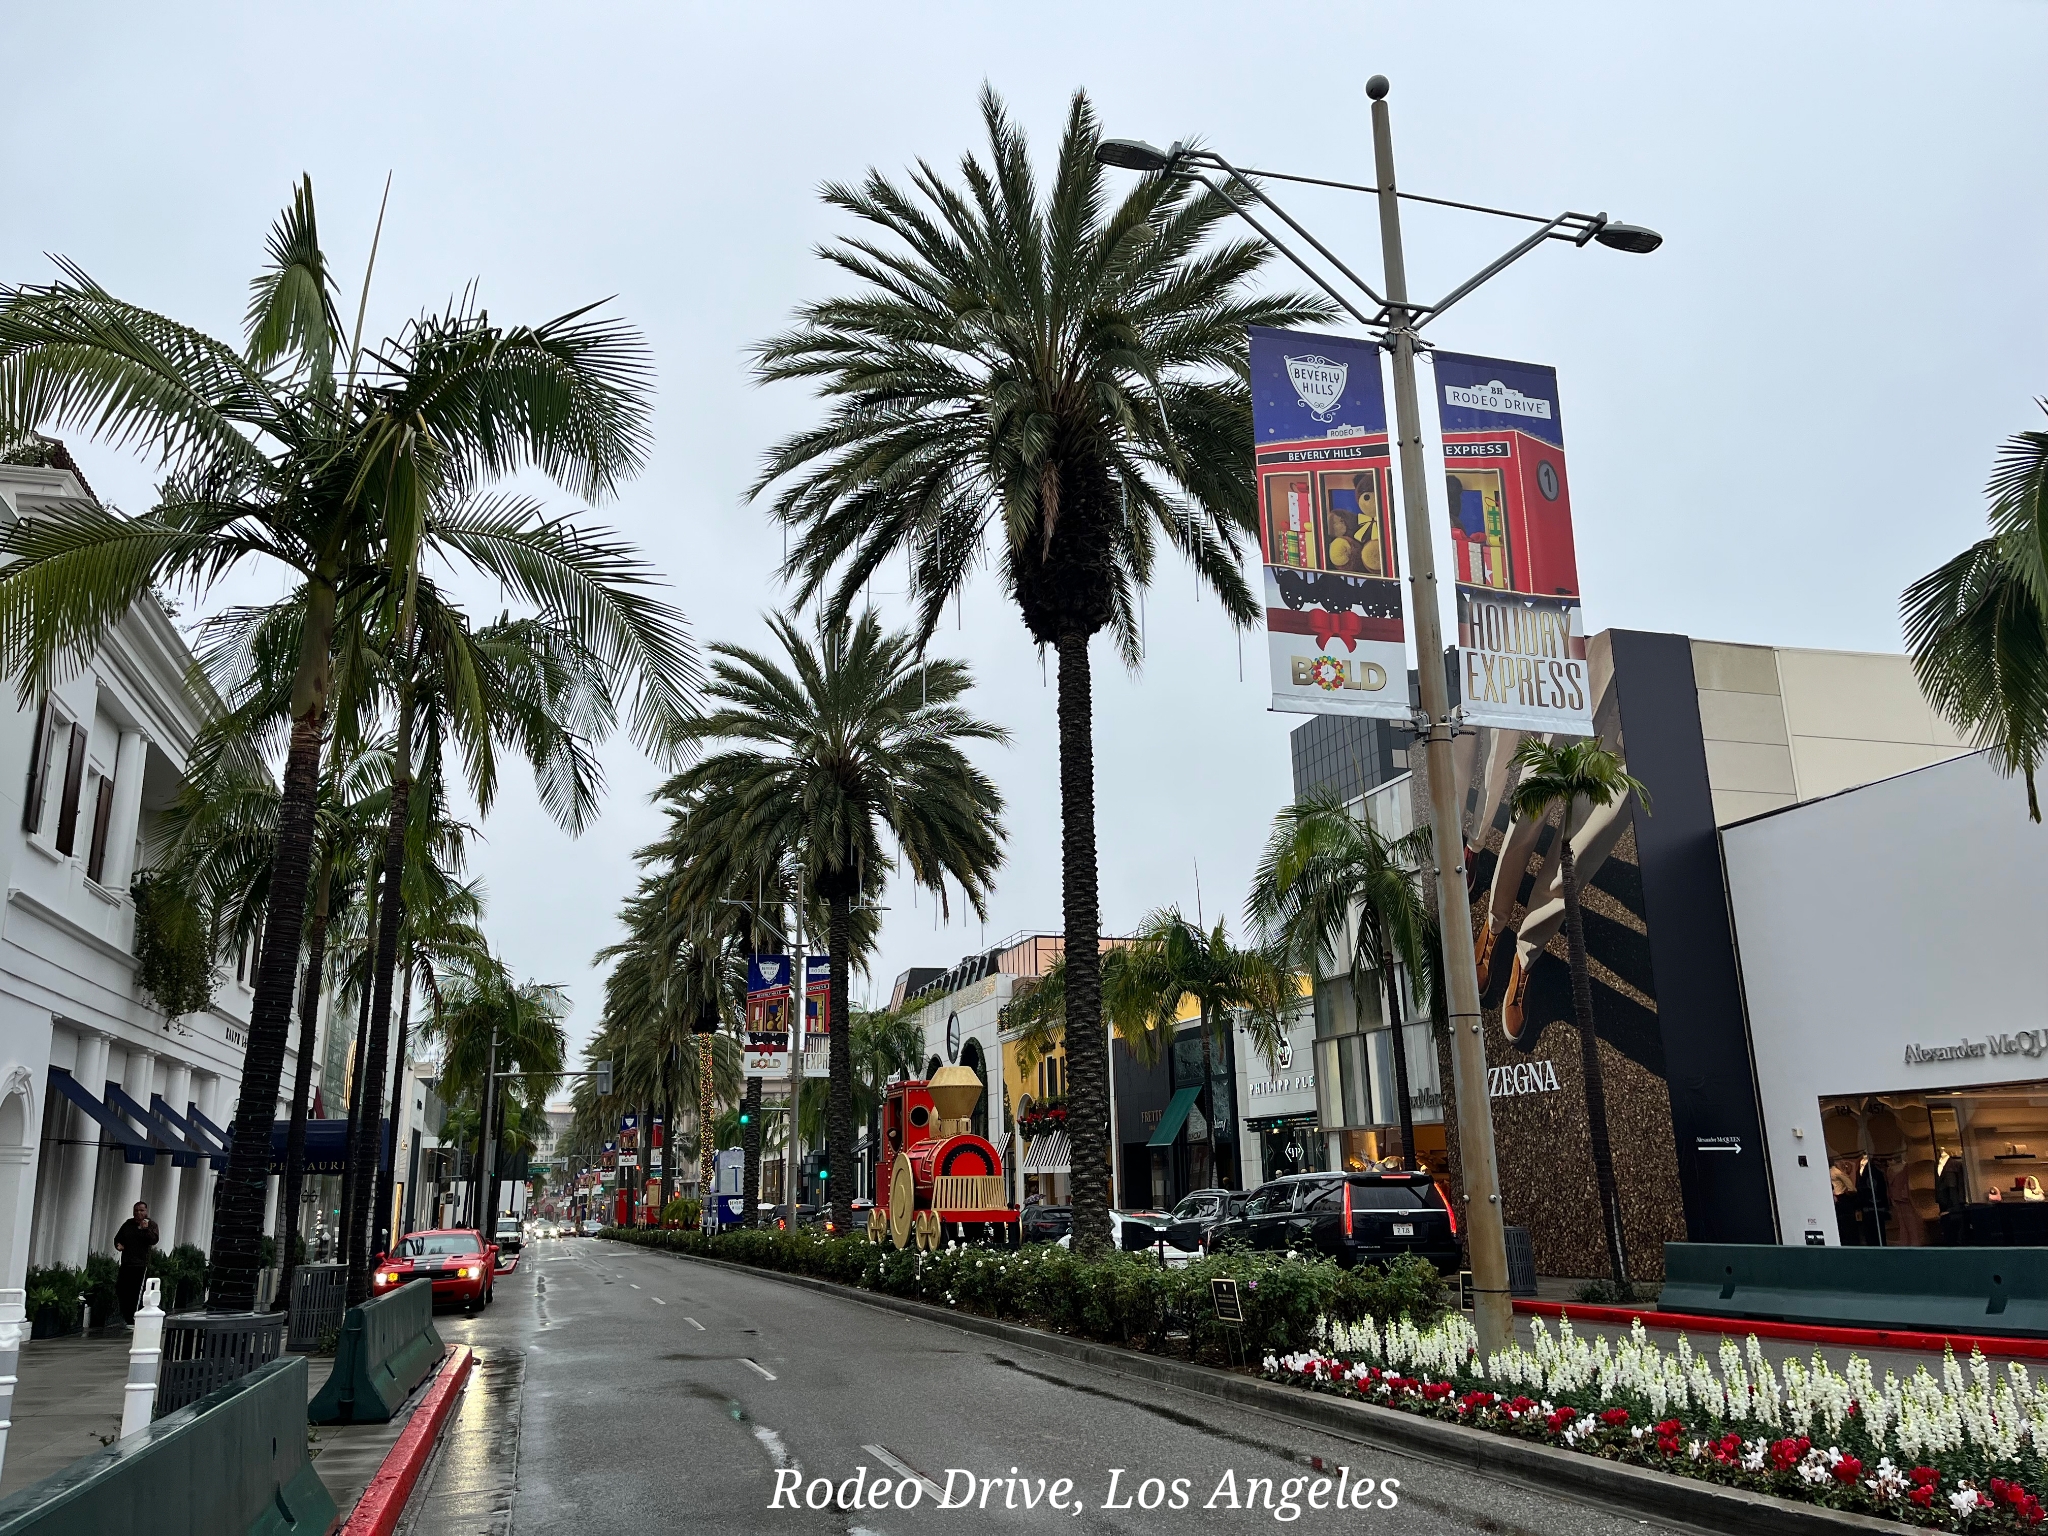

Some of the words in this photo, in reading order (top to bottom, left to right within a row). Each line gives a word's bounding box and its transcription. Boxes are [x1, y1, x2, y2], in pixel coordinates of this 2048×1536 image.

[1294, 367, 1340, 384] BEVERLY
[1302, 382, 1334, 396] HILLS
[1490, 386, 1504, 396] BH
[1452, 391, 1498, 408] RODEO
[1504, 399, 1543, 414] DRIVE
[1330, 429, 1354, 438] RODEO
[1288, 449, 1330, 461] BEVERLY
[1333, 447, 1362, 459] HILLS
[1445, 444, 1502, 455] EXPRESS
[1468, 602, 1571, 660] HOLIDAY
[1290, 655, 1387, 691] BOLD
[1466, 651, 1584, 711] EXPRESS
[1903, 1037, 1987, 1064] Alexander
[1985, 1029, 2048, 1059] McQU
[751, 1058, 782, 1070] BOLD
[1250, 1079, 1290, 1095] PHILIPP
[1295, 1075, 1316, 1089] PLE
[1487, 1060, 1560, 1097] ZEGNA
